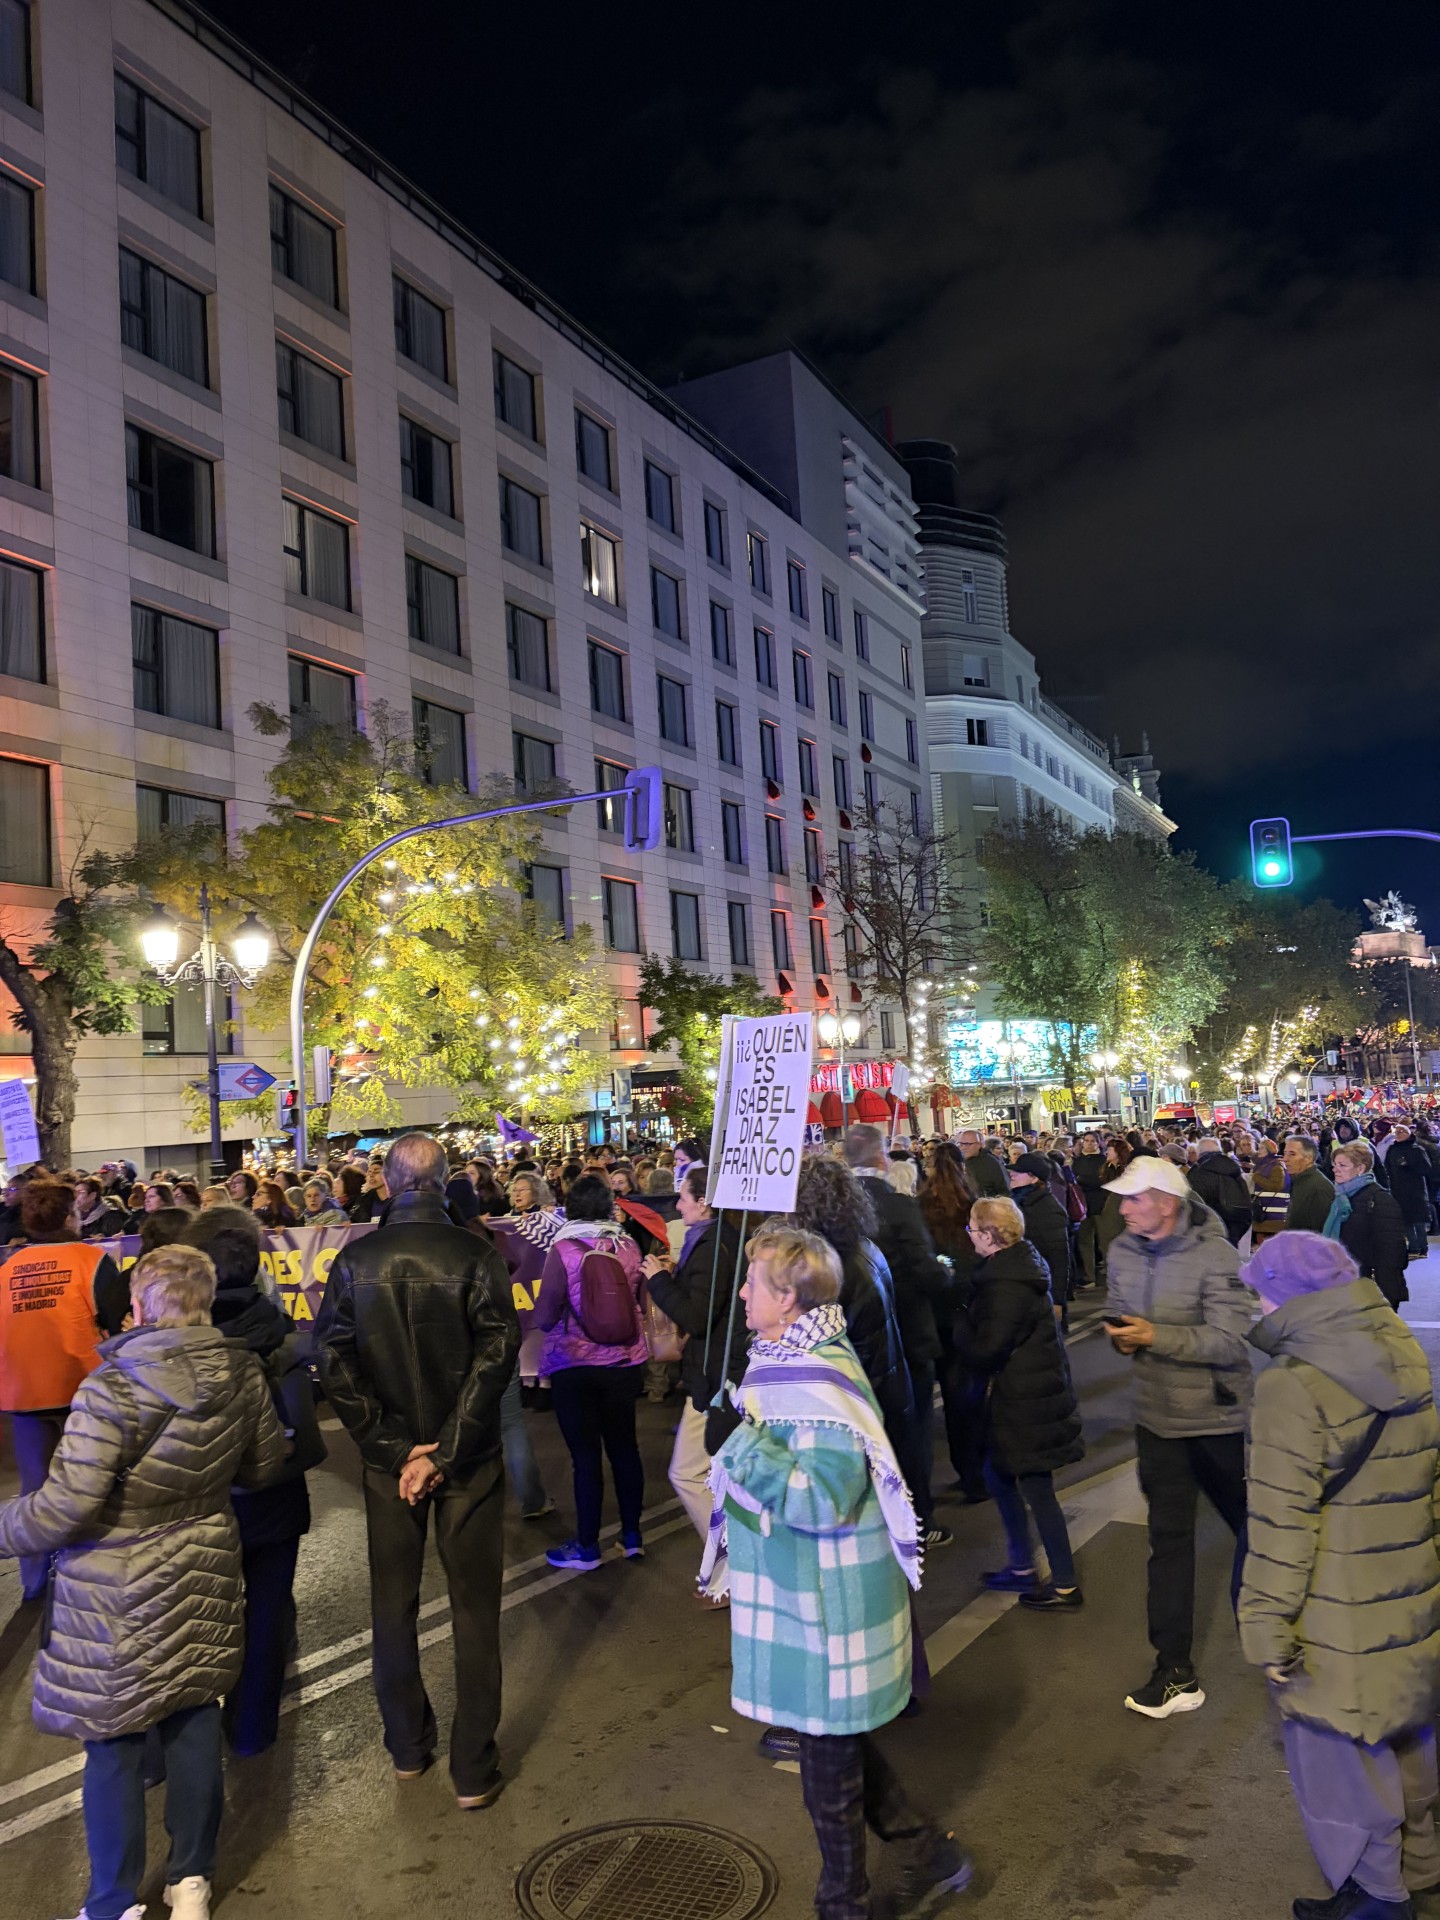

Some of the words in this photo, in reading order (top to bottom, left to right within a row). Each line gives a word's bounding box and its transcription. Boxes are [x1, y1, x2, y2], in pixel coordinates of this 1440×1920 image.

[753, 1055, 777, 1084] ES
[1130, 1075, 1142, 1088] P
[735, 1086, 796, 1116] ISABEL
[739, 1116, 780, 1145] DIAZ
[721, 1146, 795, 1177] FRANCO
[13, 1261, 57, 1275] SINDICATO
[12, 1292, 17, 1301] E
[19, 1286, 64, 1300] INQUILINOS
[13, 1303, 23, 1313] DE
[25, 1299, 57, 1311] MADRID
[745, 1867, 759, 1879] DE
